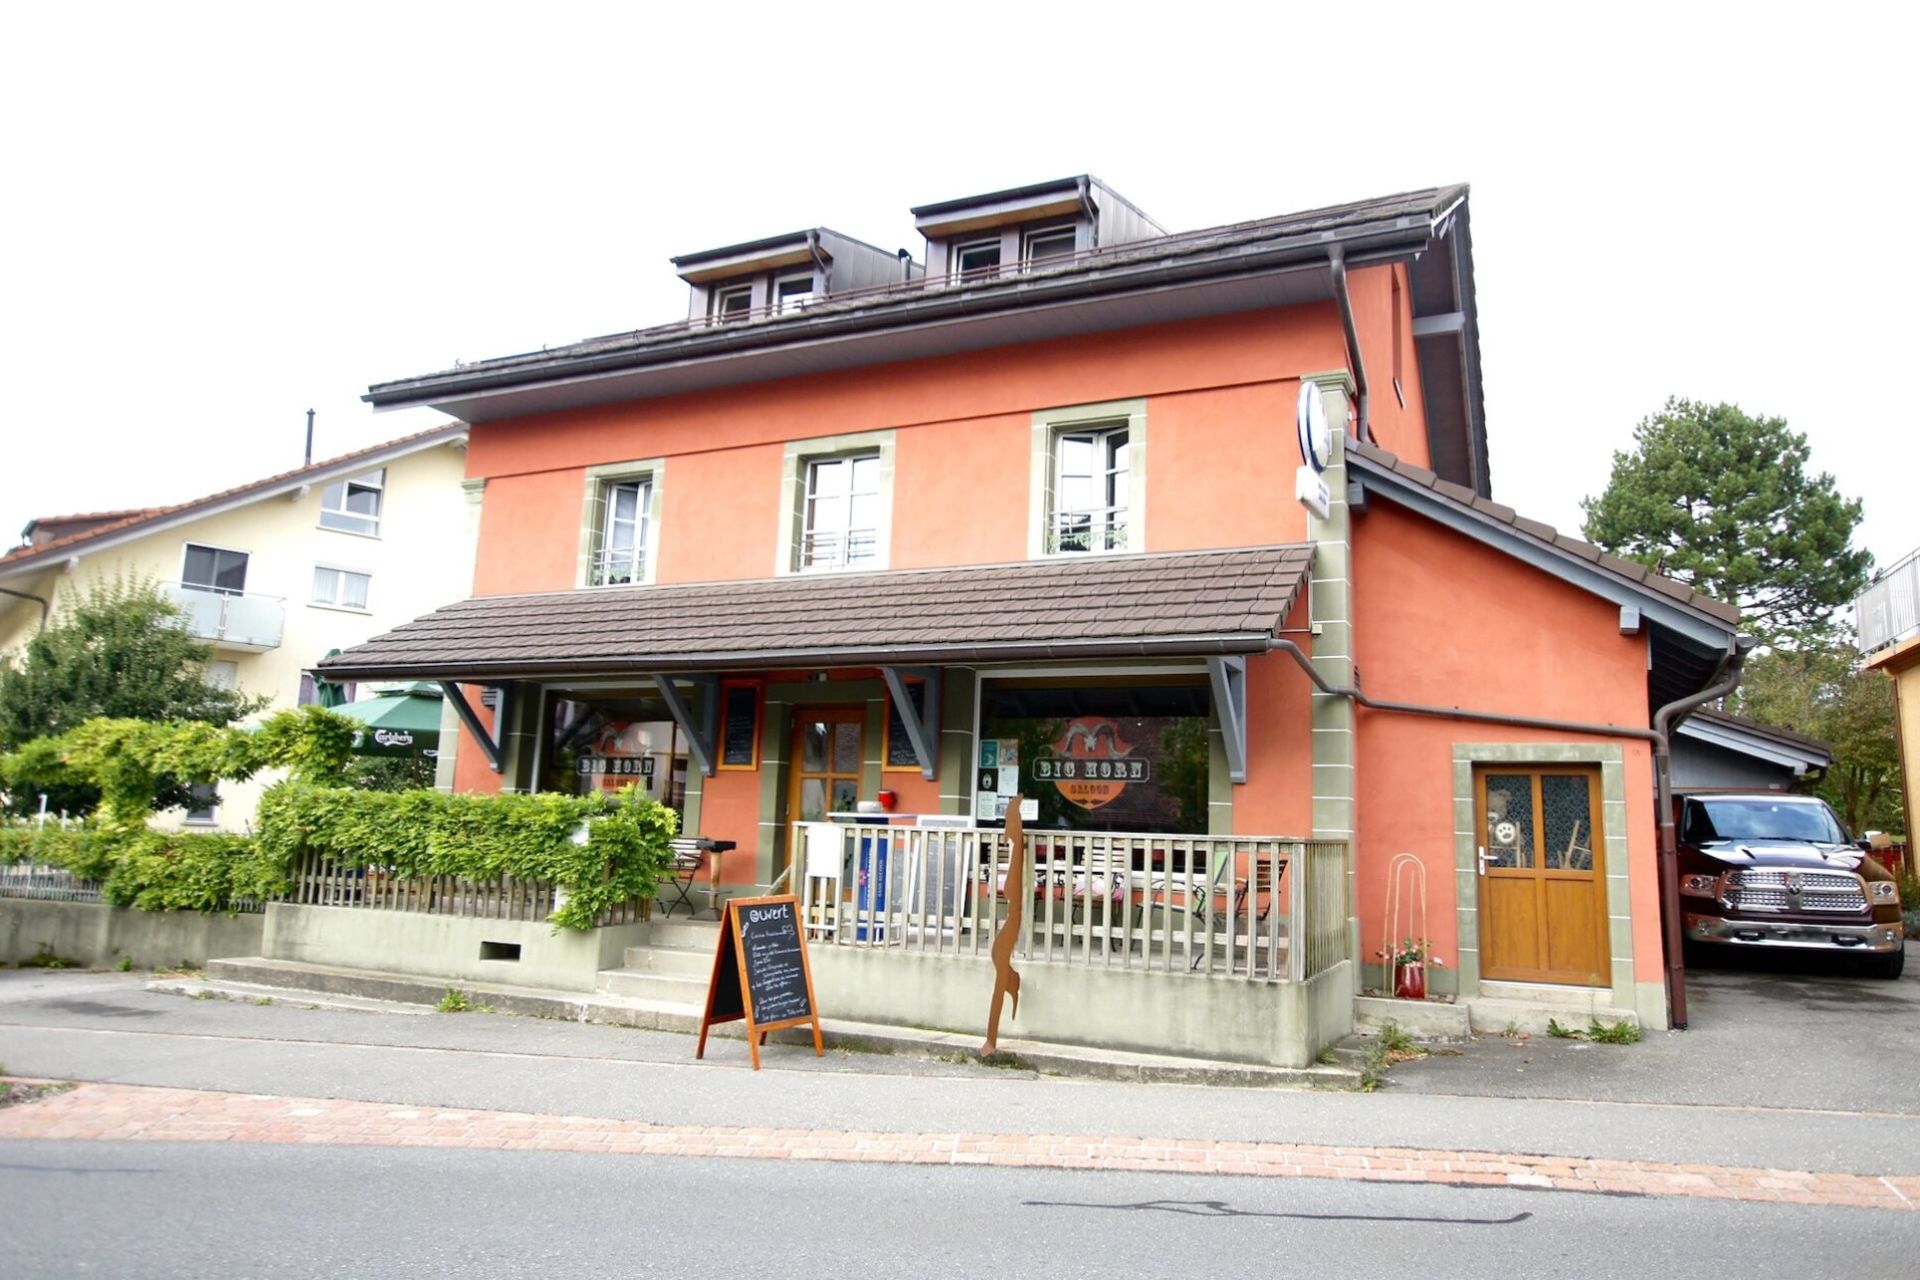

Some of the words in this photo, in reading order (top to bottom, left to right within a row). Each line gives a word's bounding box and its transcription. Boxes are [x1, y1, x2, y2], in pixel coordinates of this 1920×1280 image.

[375, 729, 413, 747] Carlsberg
[581, 759, 606, 773] BIG
[612, 759, 654, 774] HORN
[1040, 761, 1076, 778] BIG
[1085, 761, 1142, 778] HORN
[1070, 784, 1110, 795] SALOON
